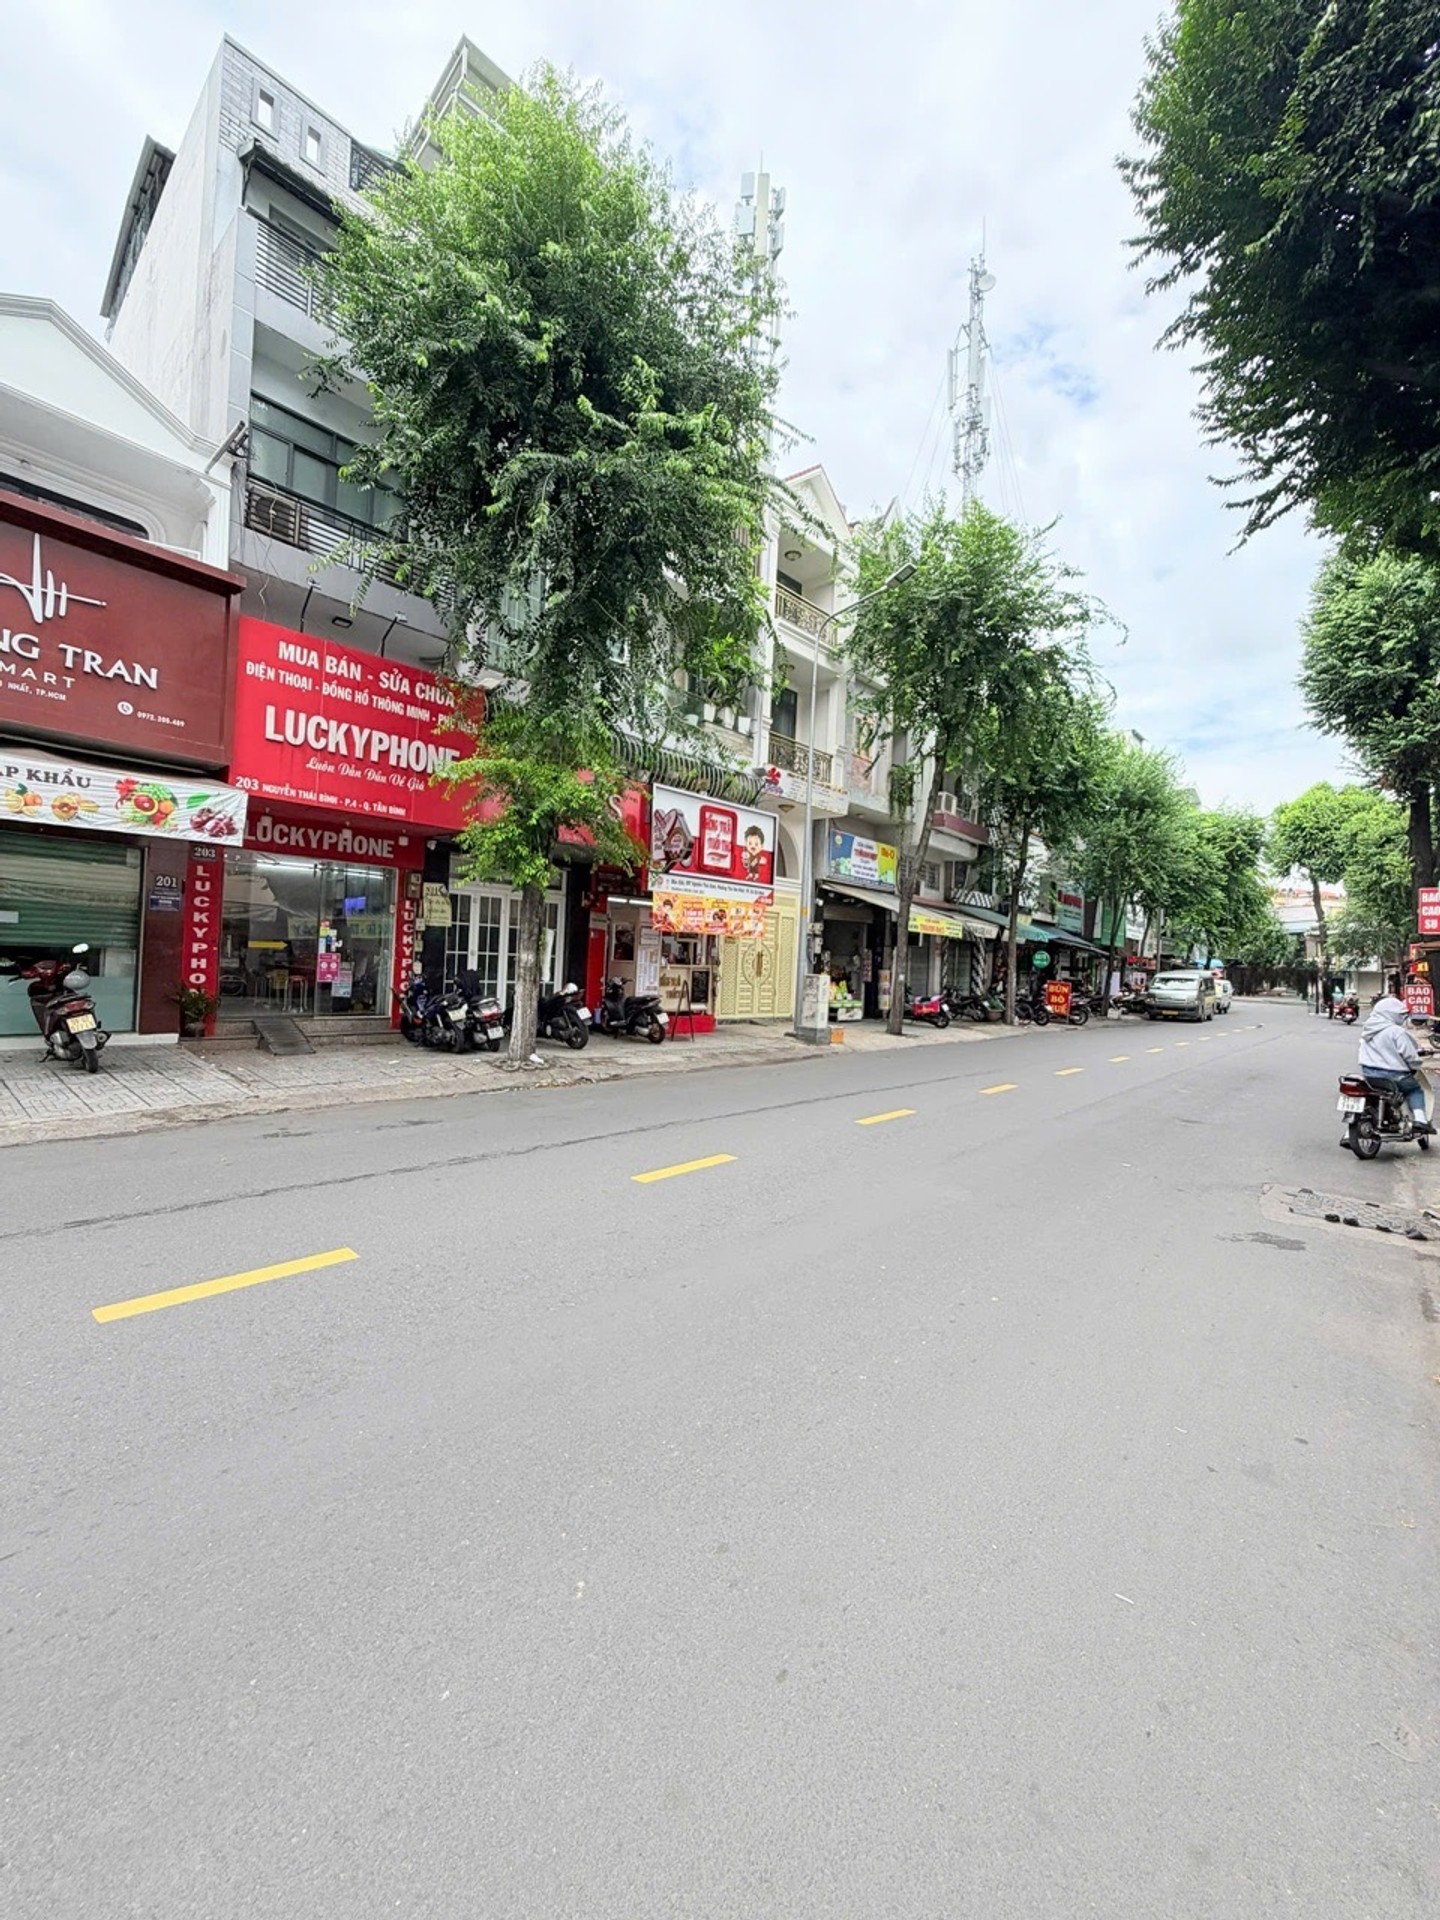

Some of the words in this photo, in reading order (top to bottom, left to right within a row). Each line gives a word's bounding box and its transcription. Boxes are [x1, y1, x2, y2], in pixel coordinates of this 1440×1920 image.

[58, 643, 158, 690] TRAN
[278, 640, 319, 669] MUA
[325, 655, 361, 681] BÁN
[379, 667, 410, 695] SỬA
[246, 660, 275, 682] ĐIỆN
[278, 669, 312, 692] THOẠI
[371, 694, 405, 716] THÔNG
[406, 704, 430, 722] MINH
[265, 704, 460, 775] LUCKYPHONE
[306, 756, 335, 773] Luôn
[26, 767, 91, 789] KHẨU
[236, 776, 259, 790] 203
[262, 783, 297, 798] NGUYỄN
[298, 789, 318, 801] THÁI
[244, 819, 394, 859] LUCKYPHONE
[194, 846, 216, 858] 203
[156, 875, 177, 888] 201
[1424, 919, 1439, 929] SU
[1407, 986, 1431, 996] BAO
[1408, 996, 1431, 1005] CAO
[1412, 1005, 1428, 1014] SU
